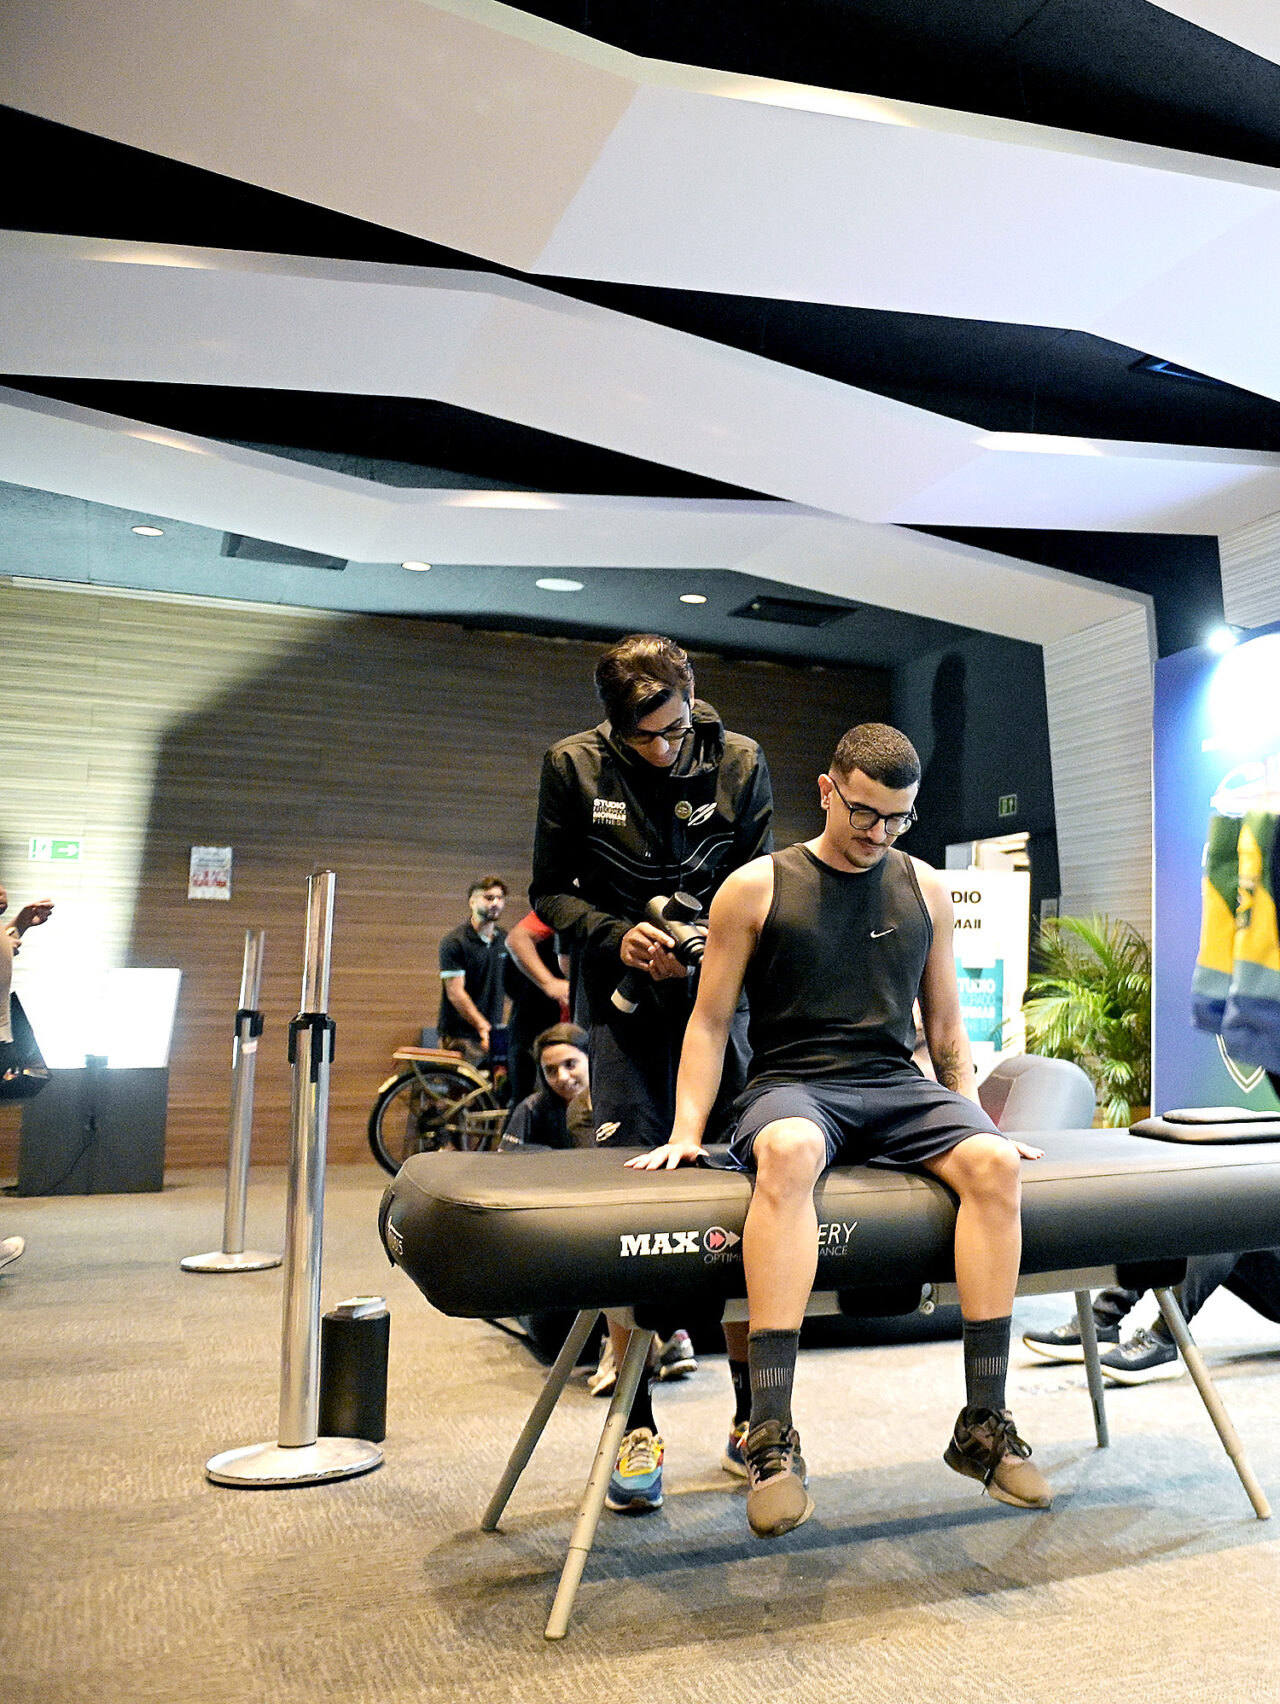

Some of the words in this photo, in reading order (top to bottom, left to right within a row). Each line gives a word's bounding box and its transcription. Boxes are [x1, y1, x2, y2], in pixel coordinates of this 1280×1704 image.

[594, 798, 626, 810] STUDIO
[951, 890, 982, 904] DIO
[957, 977, 996, 994] TUDIO
[620, 1231, 700, 1257] MAX
[817, 1221, 858, 1245] ERY
[819, 1245, 848, 1257] ANCE
